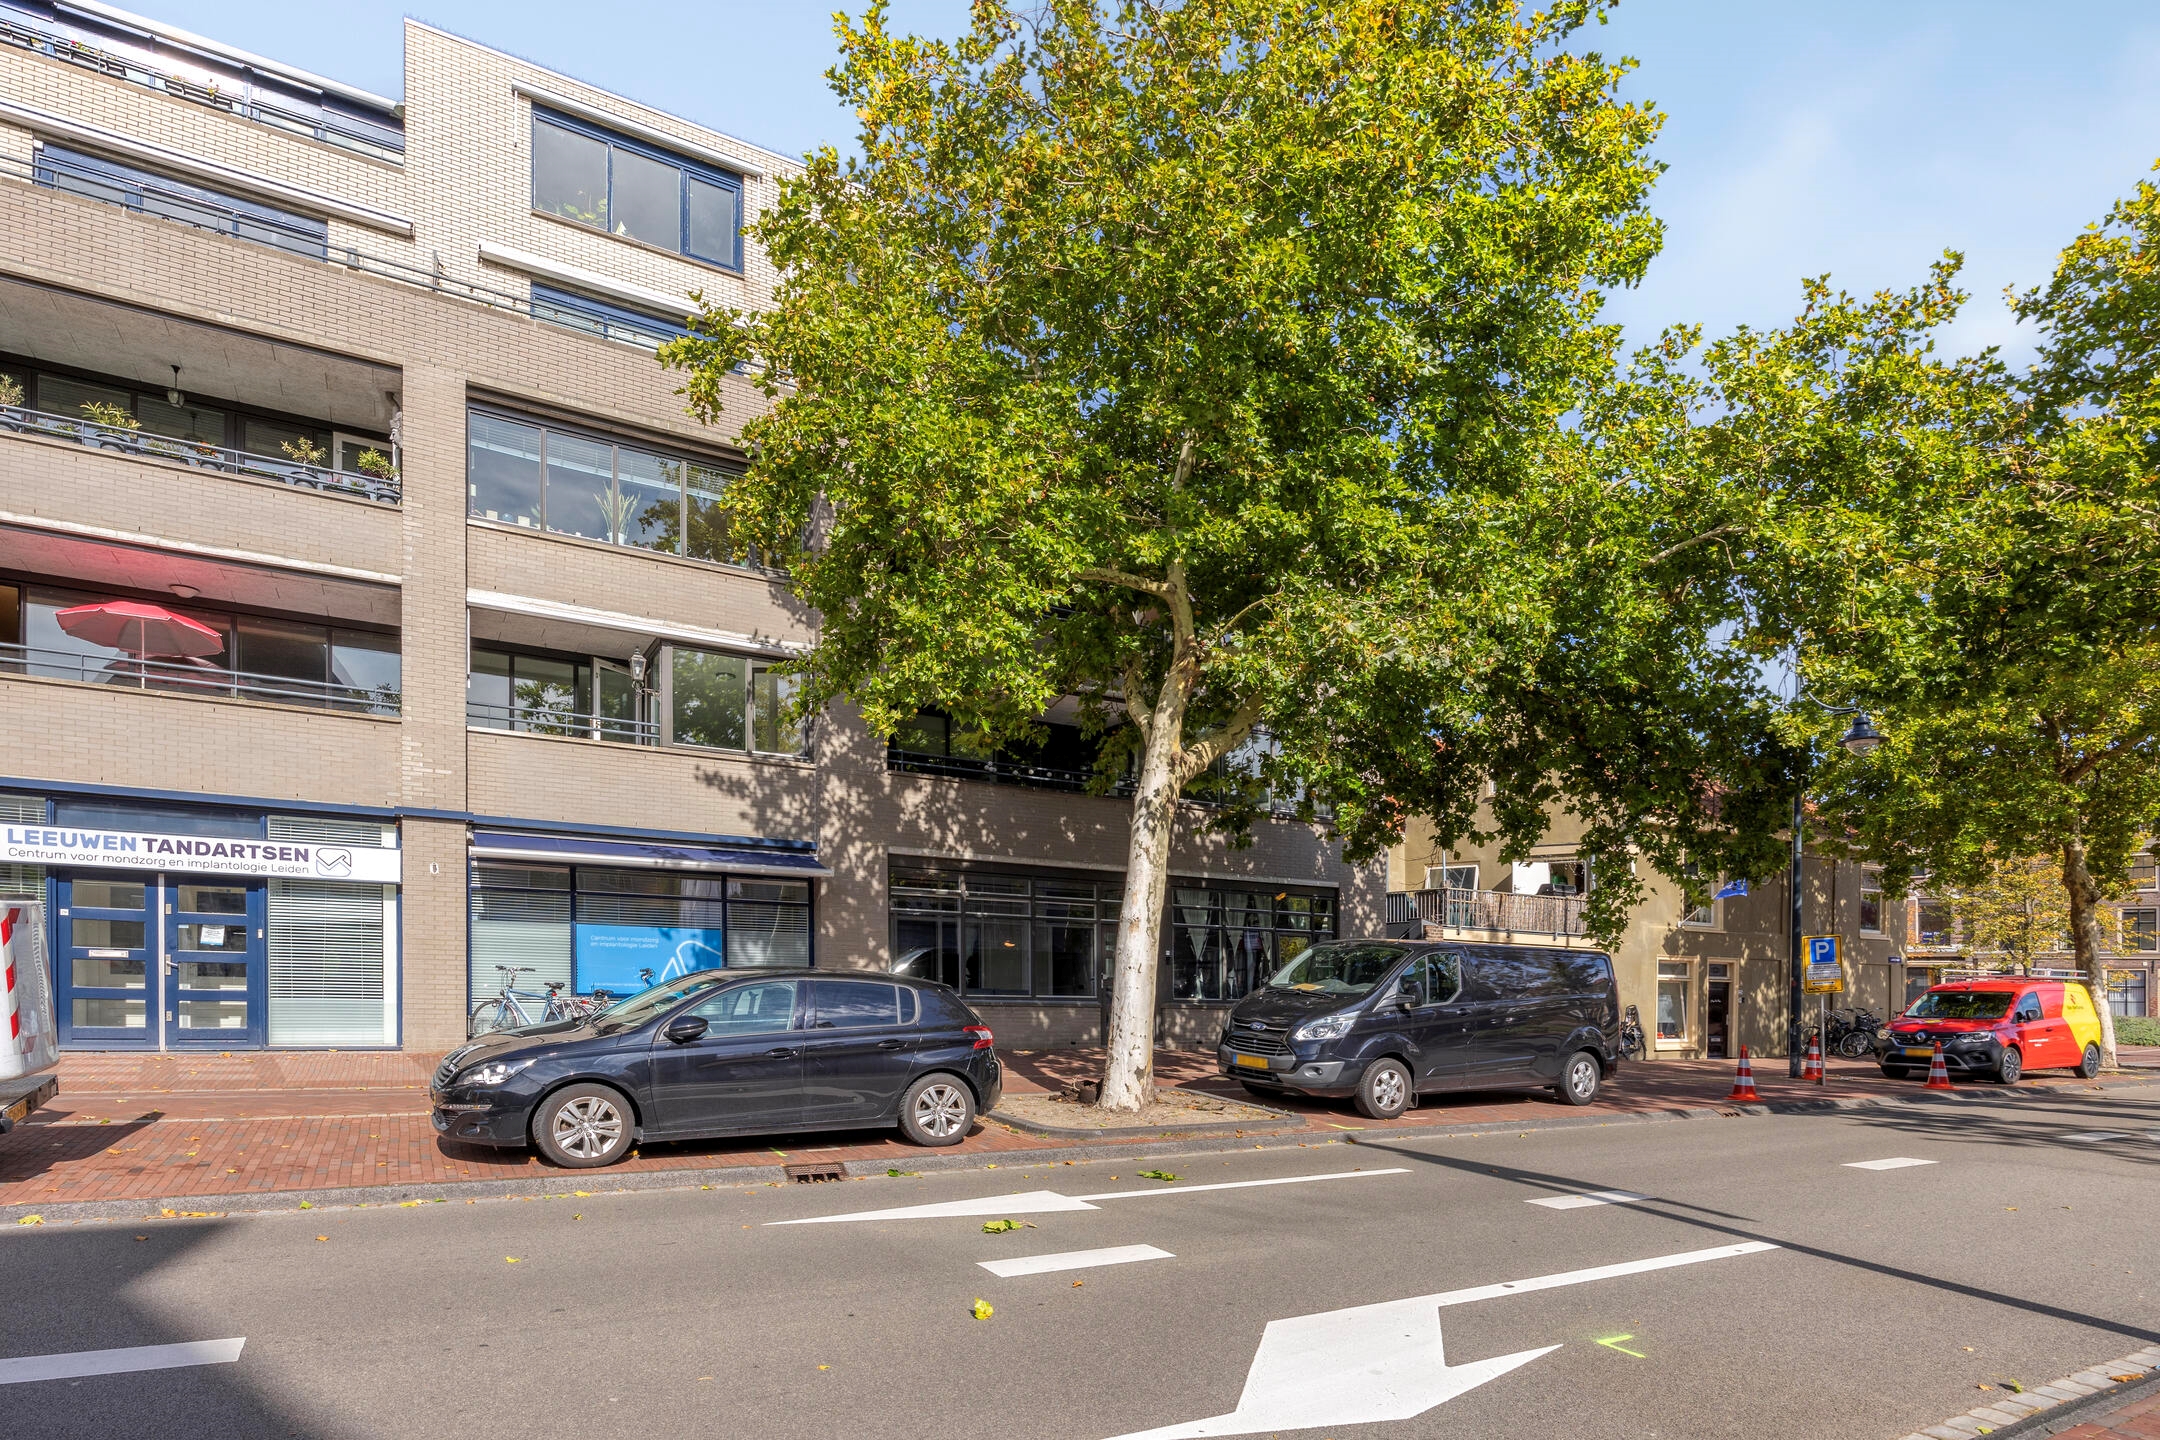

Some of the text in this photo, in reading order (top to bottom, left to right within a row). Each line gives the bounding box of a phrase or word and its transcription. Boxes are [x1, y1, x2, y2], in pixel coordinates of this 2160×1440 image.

[7, 828, 309, 862] LEEUWEN TANDARTSEN
[8, 847, 309, 874] Centrum voor mondzorg en implantologie Leiden
[1815, 941, 1830, 961] P
